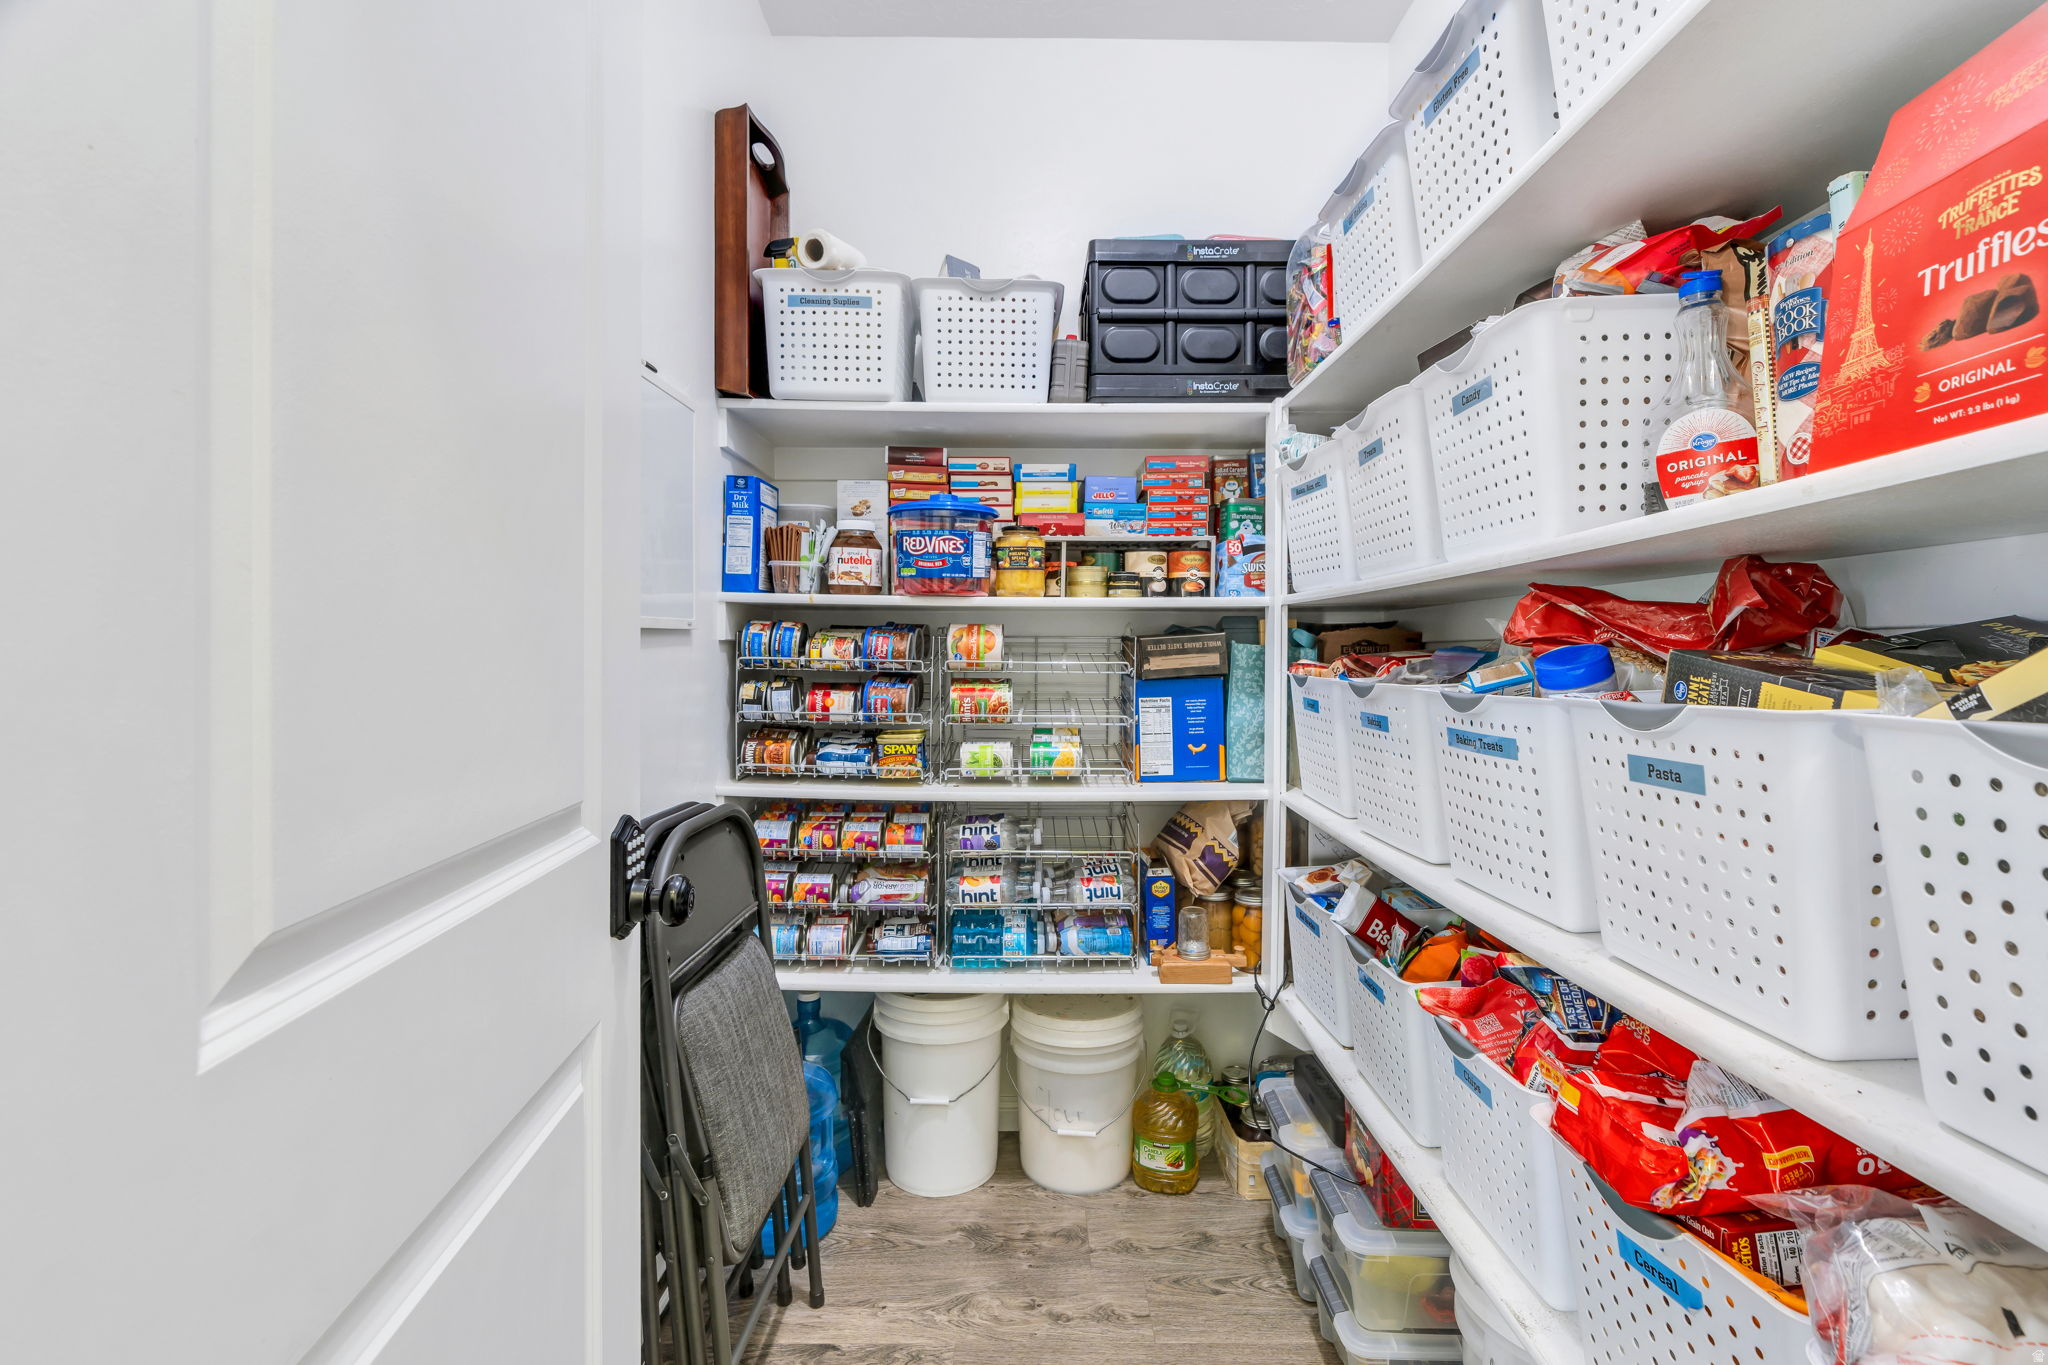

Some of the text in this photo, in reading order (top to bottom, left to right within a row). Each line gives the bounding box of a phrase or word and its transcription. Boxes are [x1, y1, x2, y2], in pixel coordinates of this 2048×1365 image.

[1433, 67, 1469, 113] Gluten Free
[1938, 166, 2043, 229] TRUFFETTES
[1953, 190, 2021, 240] FRANCE
[1193, 246, 1240, 256] InstaCrate
[1784, 250, 1814, 267] Edition
[1917, 217, 2048, 297] Truffles
[800, 297, 860, 309] Cleaning Suplies
[1777, 302, 1819, 330] COOK
[1778, 314, 1818, 342] BOOK
[1752, 361, 1765, 404] Cooking
[1782, 366, 1817, 383] NEW Recipes
[1938, 359, 2016, 393] ORIGINAL
[1193, 381, 1240, 391] InstaCrate
[1790, 378, 1801, 388] Tips
[1798, 380, 1818, 391] Photos
[1461, 387, 1481, 407] Candy
[1933, 410, 1949, 425] Net
[1967, 402, 1981, 416] 2.2
[1982, 399, 1994, 412] lbs
[1692, 437, 1716, 448] Kroger
[1667, 450, 1747, 473] ORIGINAL
[1674, 470, 1709, 485] pancake
[1681, 480, 1705, 488] syrup
[732, 501, 749, 509] Milk
[734, 494, 748, 503] Dry
[1228, 542, 1241, 552] 50
[837, 553, 872, 566] nutella
[1981, 622, 2044, 638] PENN
[1167, 642, 1182, 650] TASTE
[1602, 691, 1627, 701] MERICA
[1687, 675, 1701, 705] ENNE
[1697, 676, 1712, 705] GATE
[883, 744, 917, 755] SPAM
[1456, 733, 1504, 753] Baking Treats
[1647, 764, 1682, 784] Pasta
[961, 824, 998, 837] hint
[1086, 863, 1120, 878] hint
[961, 888, 998, 904] hint
[1087, 886, 1121, 902] hint
[1558, 980, 1578, 1028] TASTE OF
[1497, 1030, 1512, 1039] fruits
[1496, 1046, 1509, 1054] than
[1463, 1069, 1482, 1095] Chips
[1782, 1166, 1804, 1184] FREE!
[1686, 1216, 1715, 1240] Grain Oats
[1786, 1231, 1795, 1244] 210
[1738, 1237, 1753, 1267] erios
[1789, 1247, 1798, 1260] 140
[1634, 1249, 1680, 1296] Cereal
